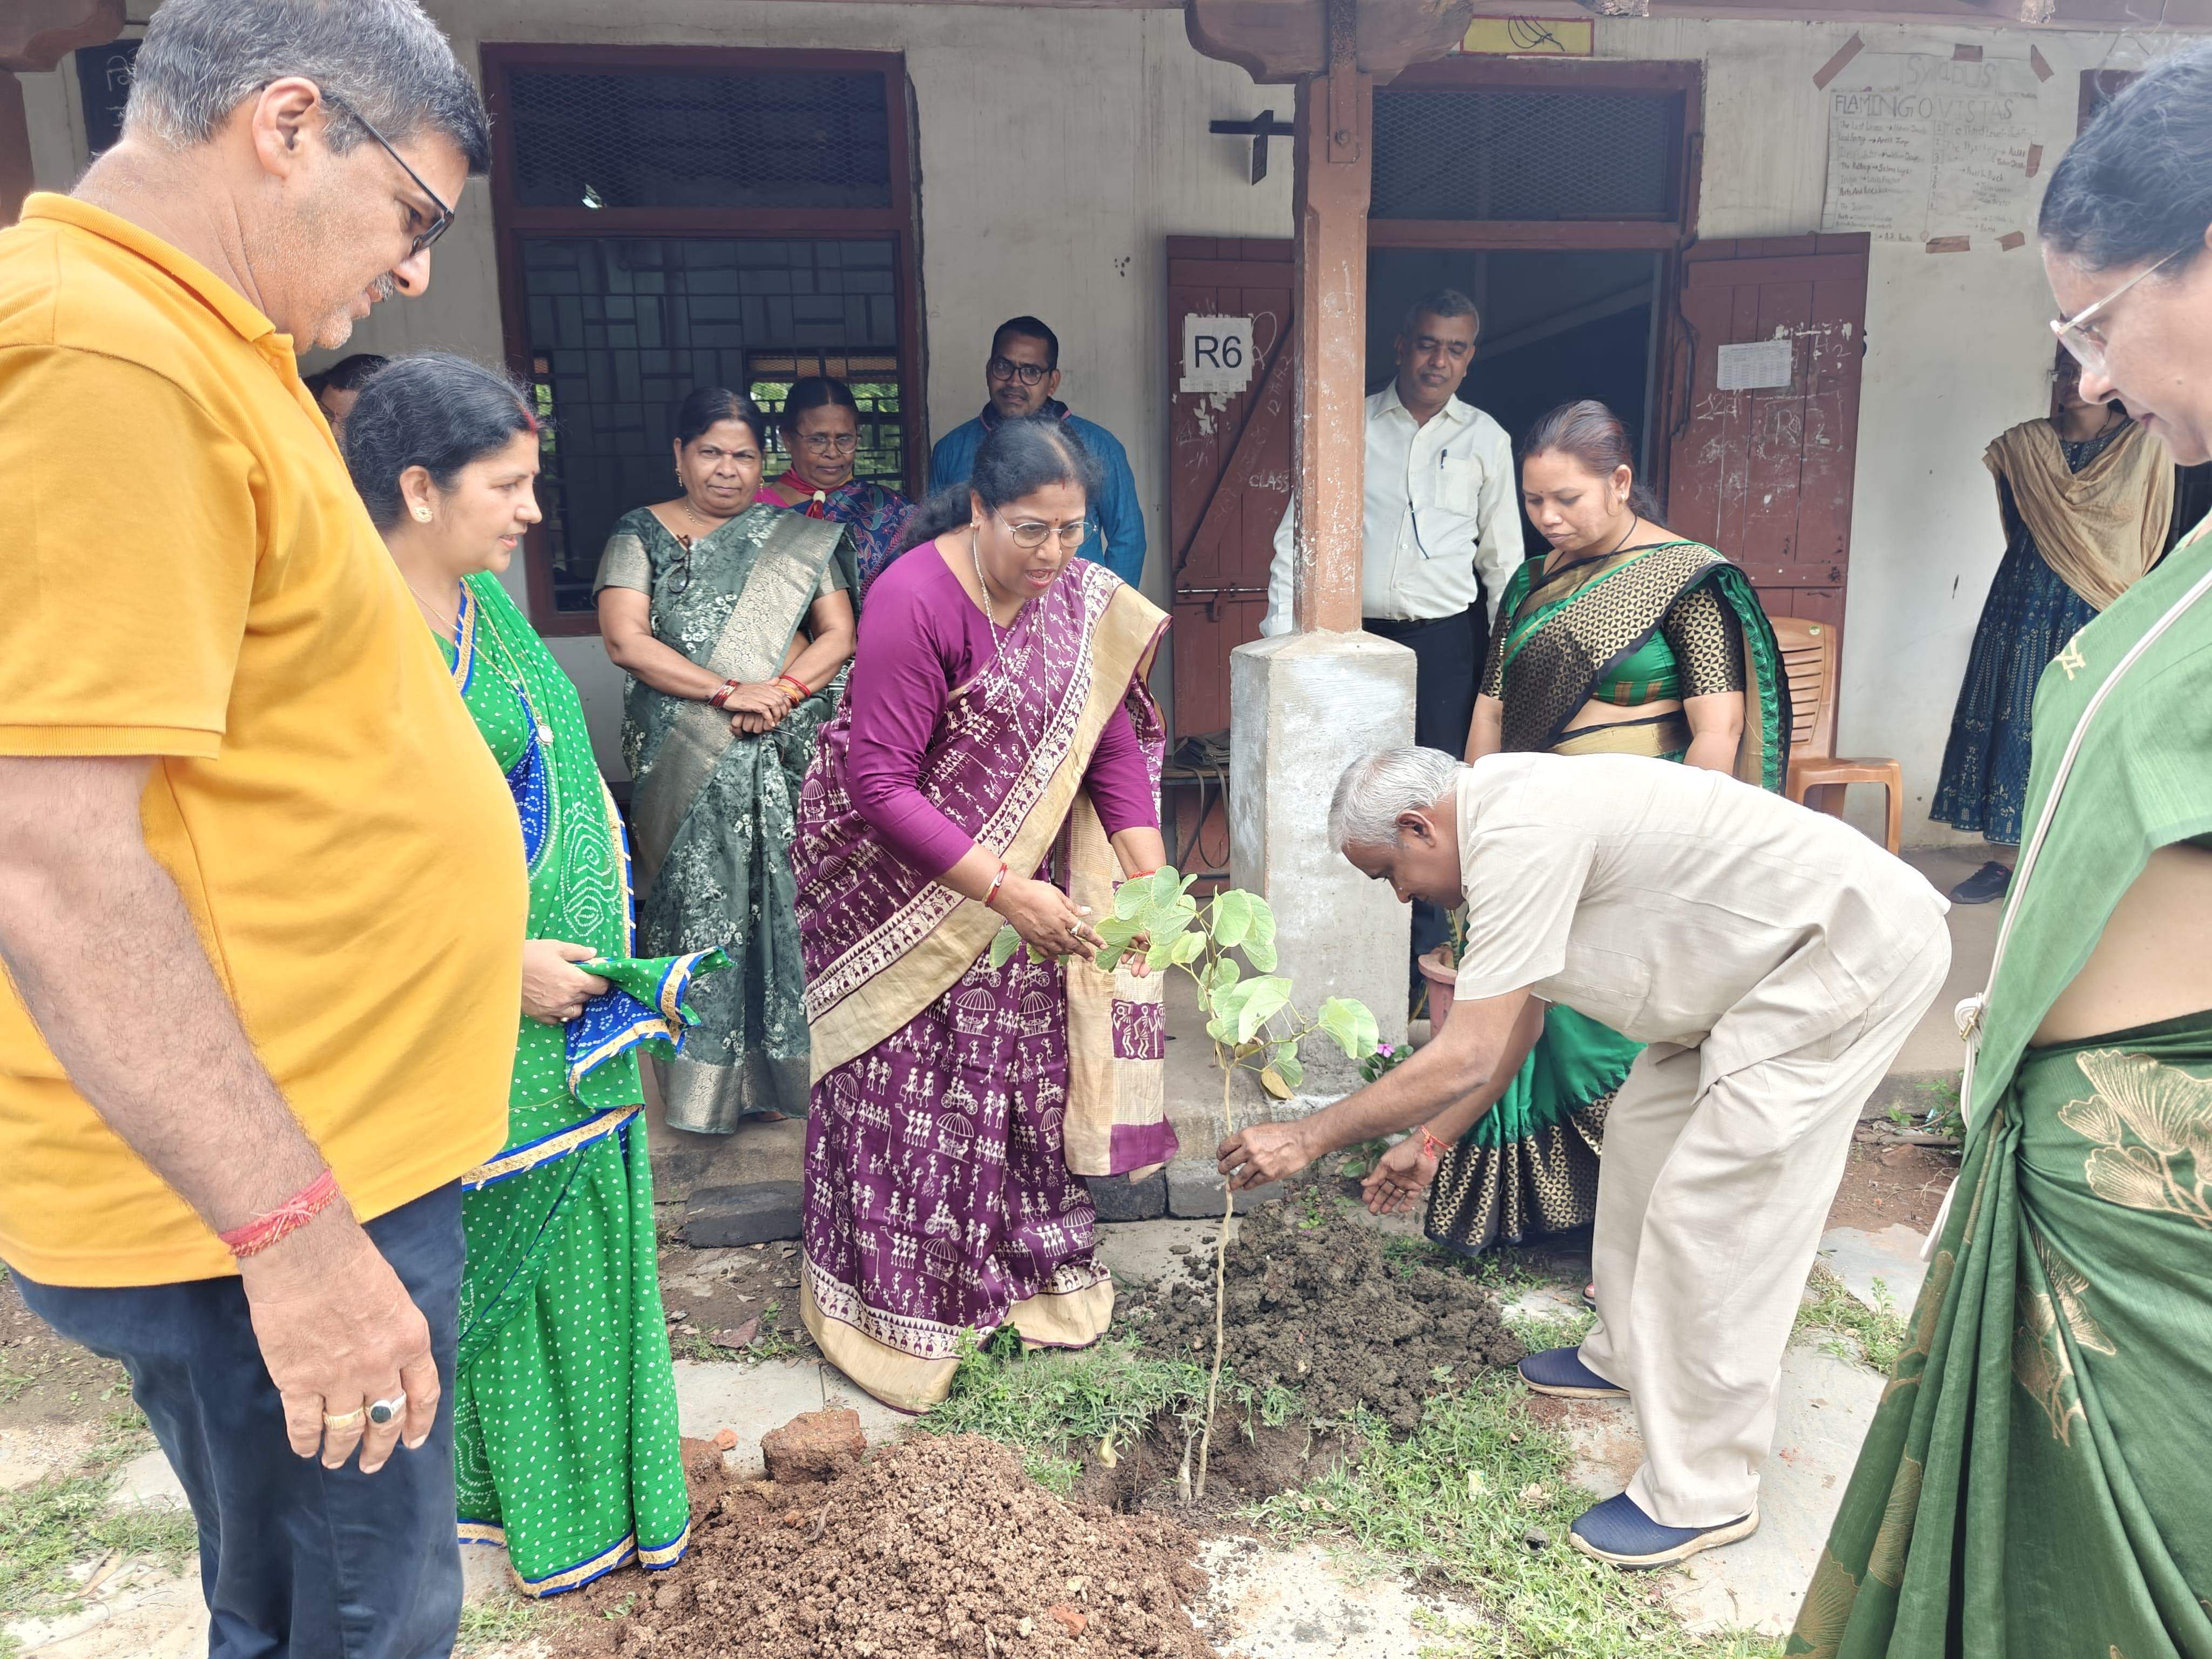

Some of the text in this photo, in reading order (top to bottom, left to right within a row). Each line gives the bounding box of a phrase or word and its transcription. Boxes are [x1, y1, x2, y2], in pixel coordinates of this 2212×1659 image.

[1835, 94, 2014, 123] FLAMINGO VISTAS
[1195, 335, 1242, 368] R6
[1249, 471, 1290, 493] CLASS
